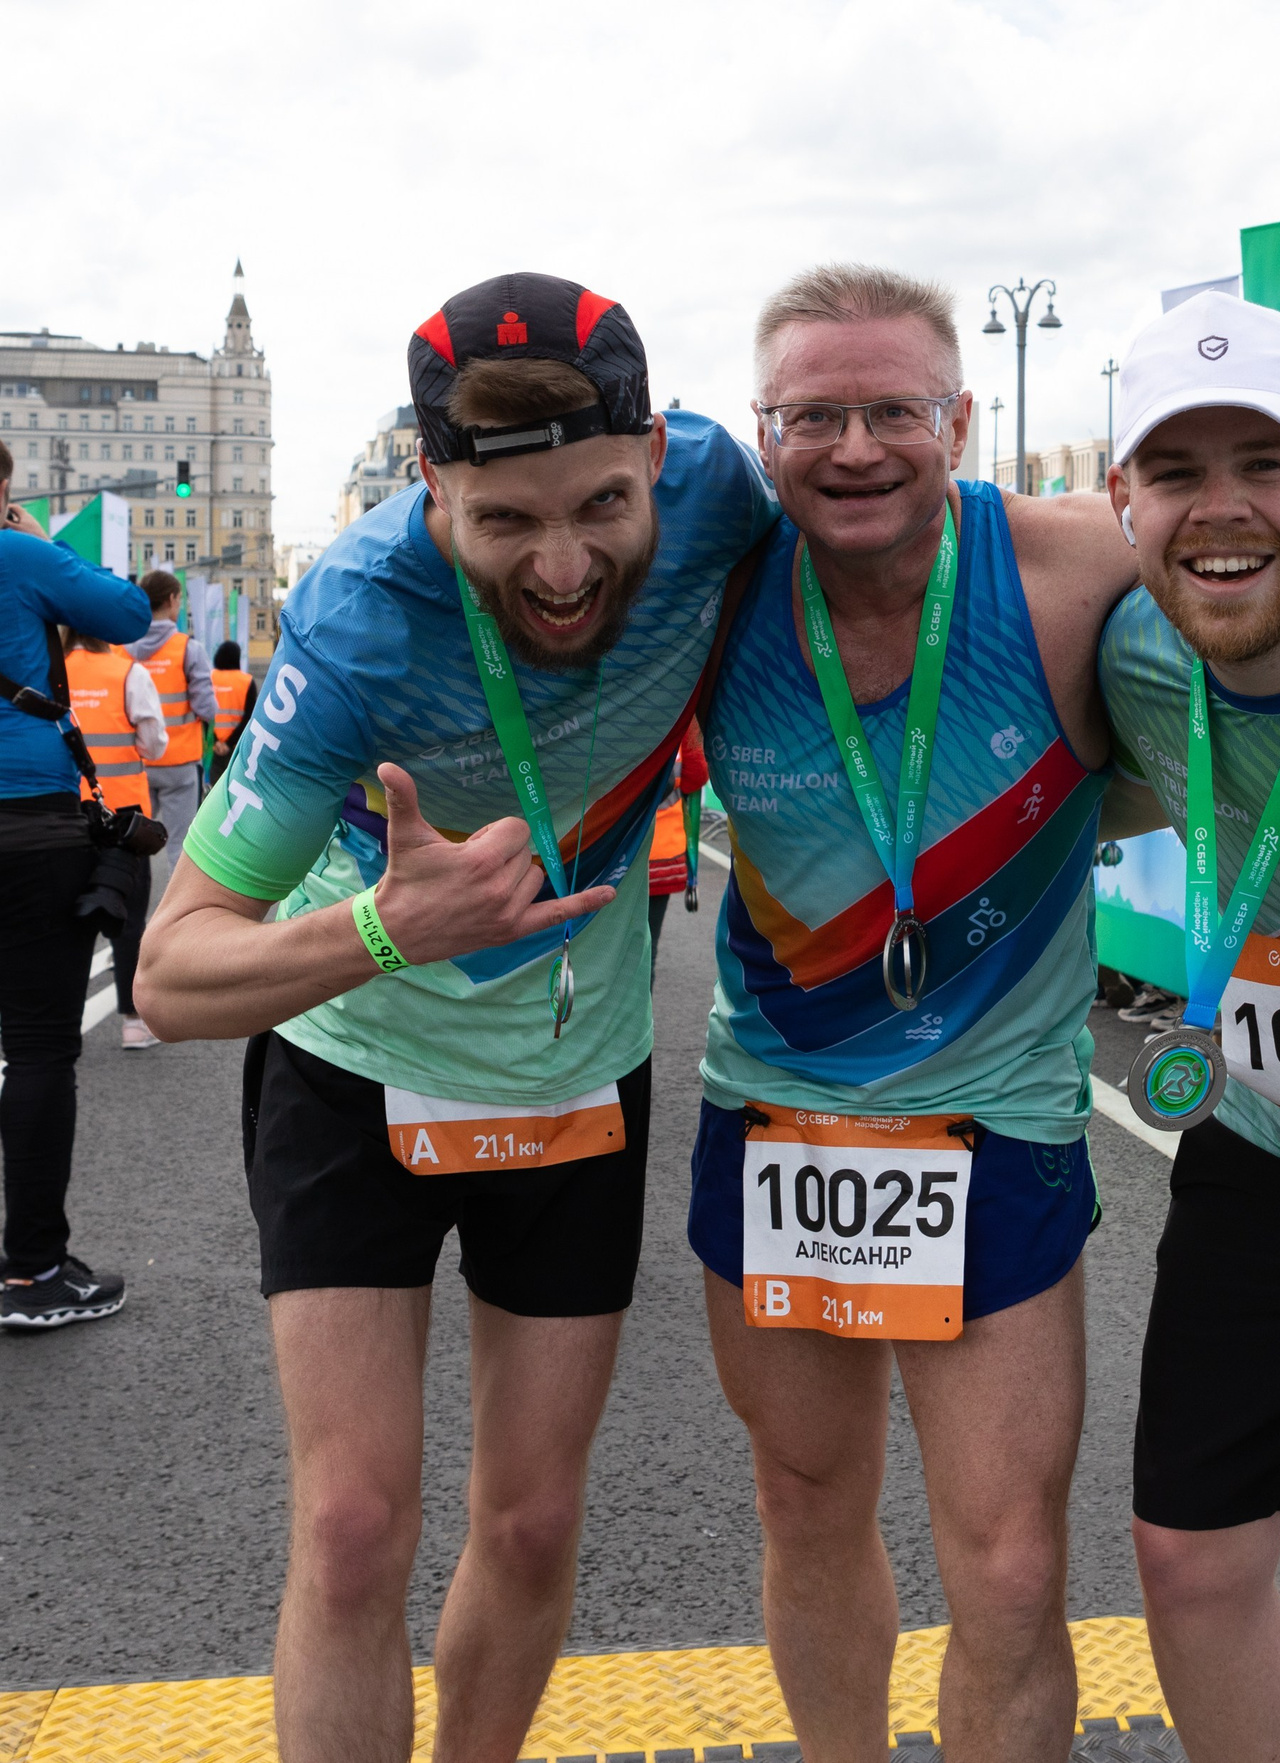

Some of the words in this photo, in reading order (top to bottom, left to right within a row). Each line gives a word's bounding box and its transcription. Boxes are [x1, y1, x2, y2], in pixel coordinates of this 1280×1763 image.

[942, 553, 951, 588] марафон
[930, 602, 942, 631] СБЕР
[477, 623, 491, 660] марафон
[484, 627, 503, 662] зелёный
[731, 745, 776, 765] SBER
[851, 750, 868, 778] СБЕР
[915, 748, 924, 785] марафон
[523, 775, 539, 804] СБЕР
[729, 769, 838, 789] TRIATHLON
[729, 793, 778, 813] TEAM
[865, 793, 881, 828] марафон
[906, 800, 915, 828] СБЕР
[1197, 843, 1206, 875] СБЕР
[1248, 843, 1267, 881] зелёный
[1254, 850, 1273, 888] марафон
[1193, 891, 1201, 930] марафон
[1202, 896, 1210, 934] зелёный
[1232, 902, 1249, 933] СБЕР
[363, 921, 383, 946] 21,1
[374, 945, 410, 972] 26
[809, 1114, 839, 1125] СБЕР
[855, 1122, 890, 1130] марафон
[411, 1128, 440, 1165] A
[473, 1133, 514, 1162] 21,1
[757, 1163, 958, 1238] 10025
[795, 1239, 912, 1269] АЛЕКСАНДР
[766, 1280, 791, 1316] B
[821, 1295, 853, 1328] 21,1
